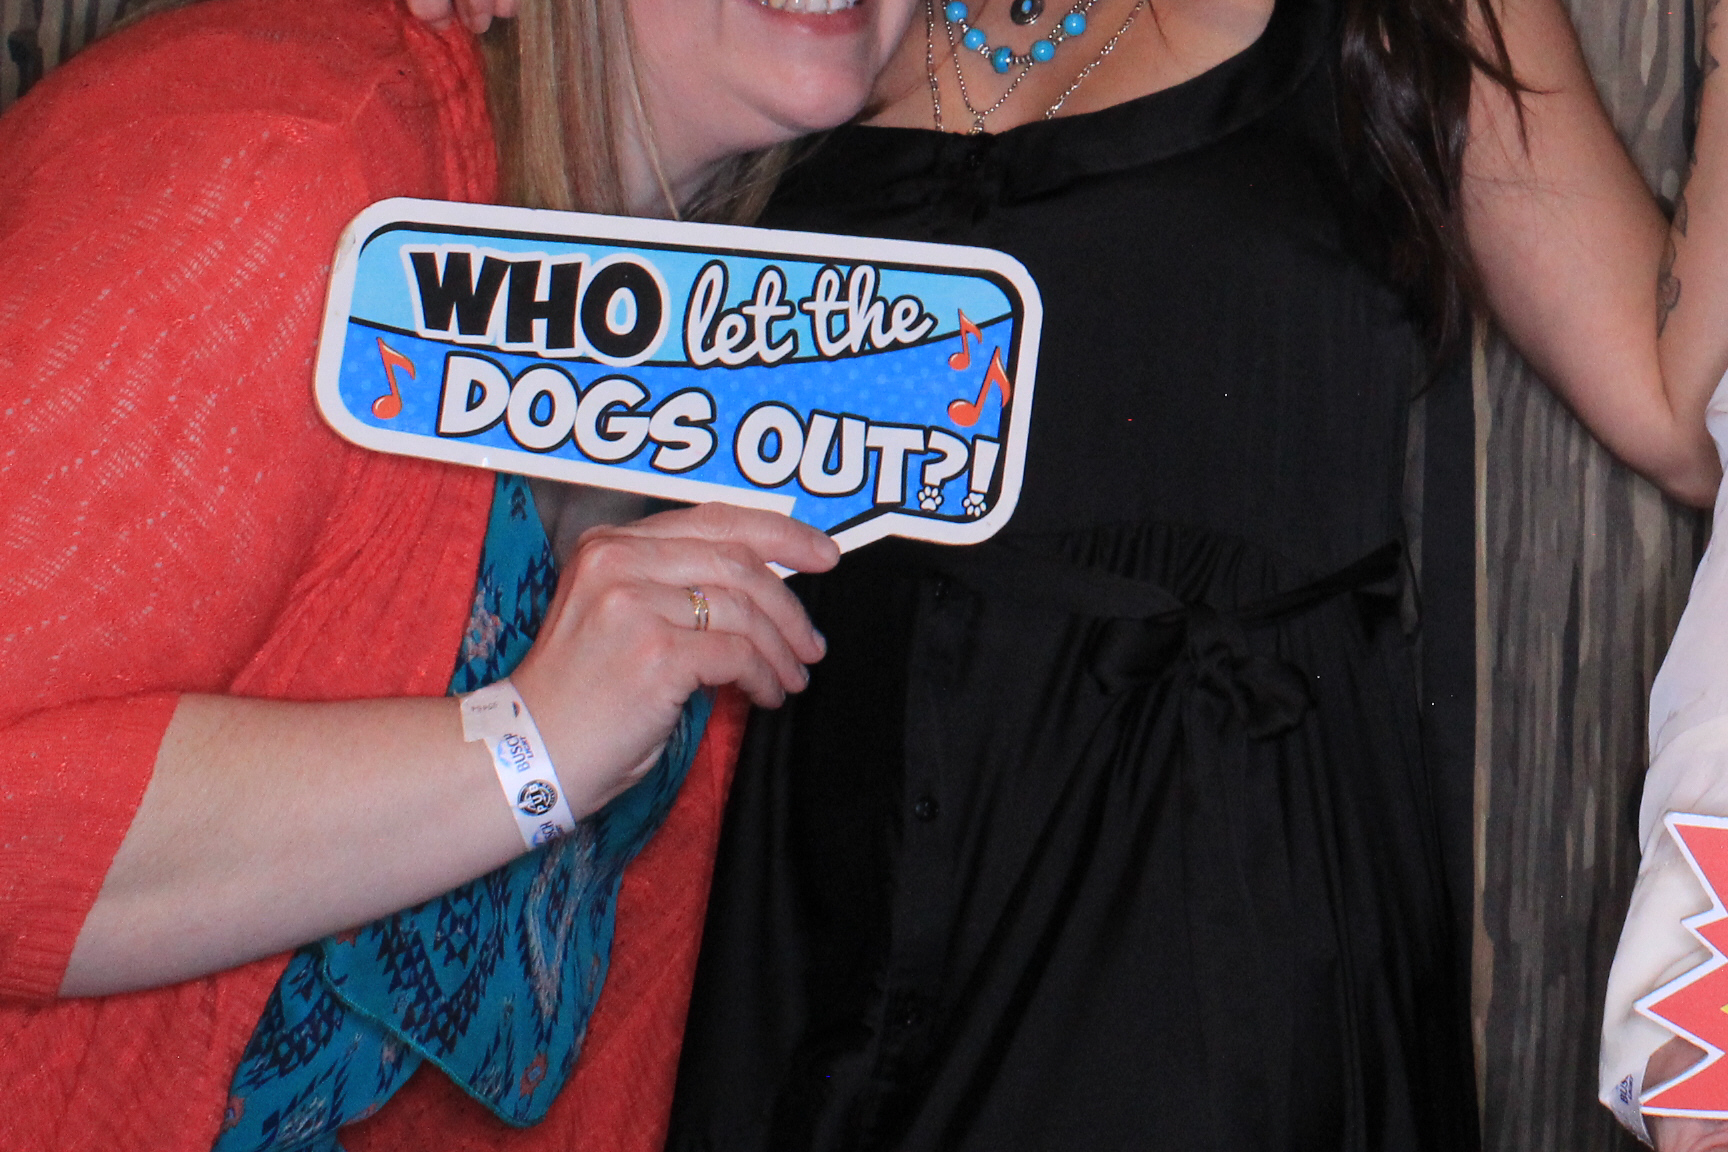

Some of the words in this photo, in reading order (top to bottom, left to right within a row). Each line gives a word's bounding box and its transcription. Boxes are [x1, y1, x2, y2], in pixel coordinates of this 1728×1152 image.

[409, 251, 663, 359] WHO
[687, 262, 796, 365] let
[803, 265, 936, 355] the
[438, 353, 718, 473] DOGS
[734, 403, 1001, 519] OUT?!
[528, 783, 546, 815] PUB
